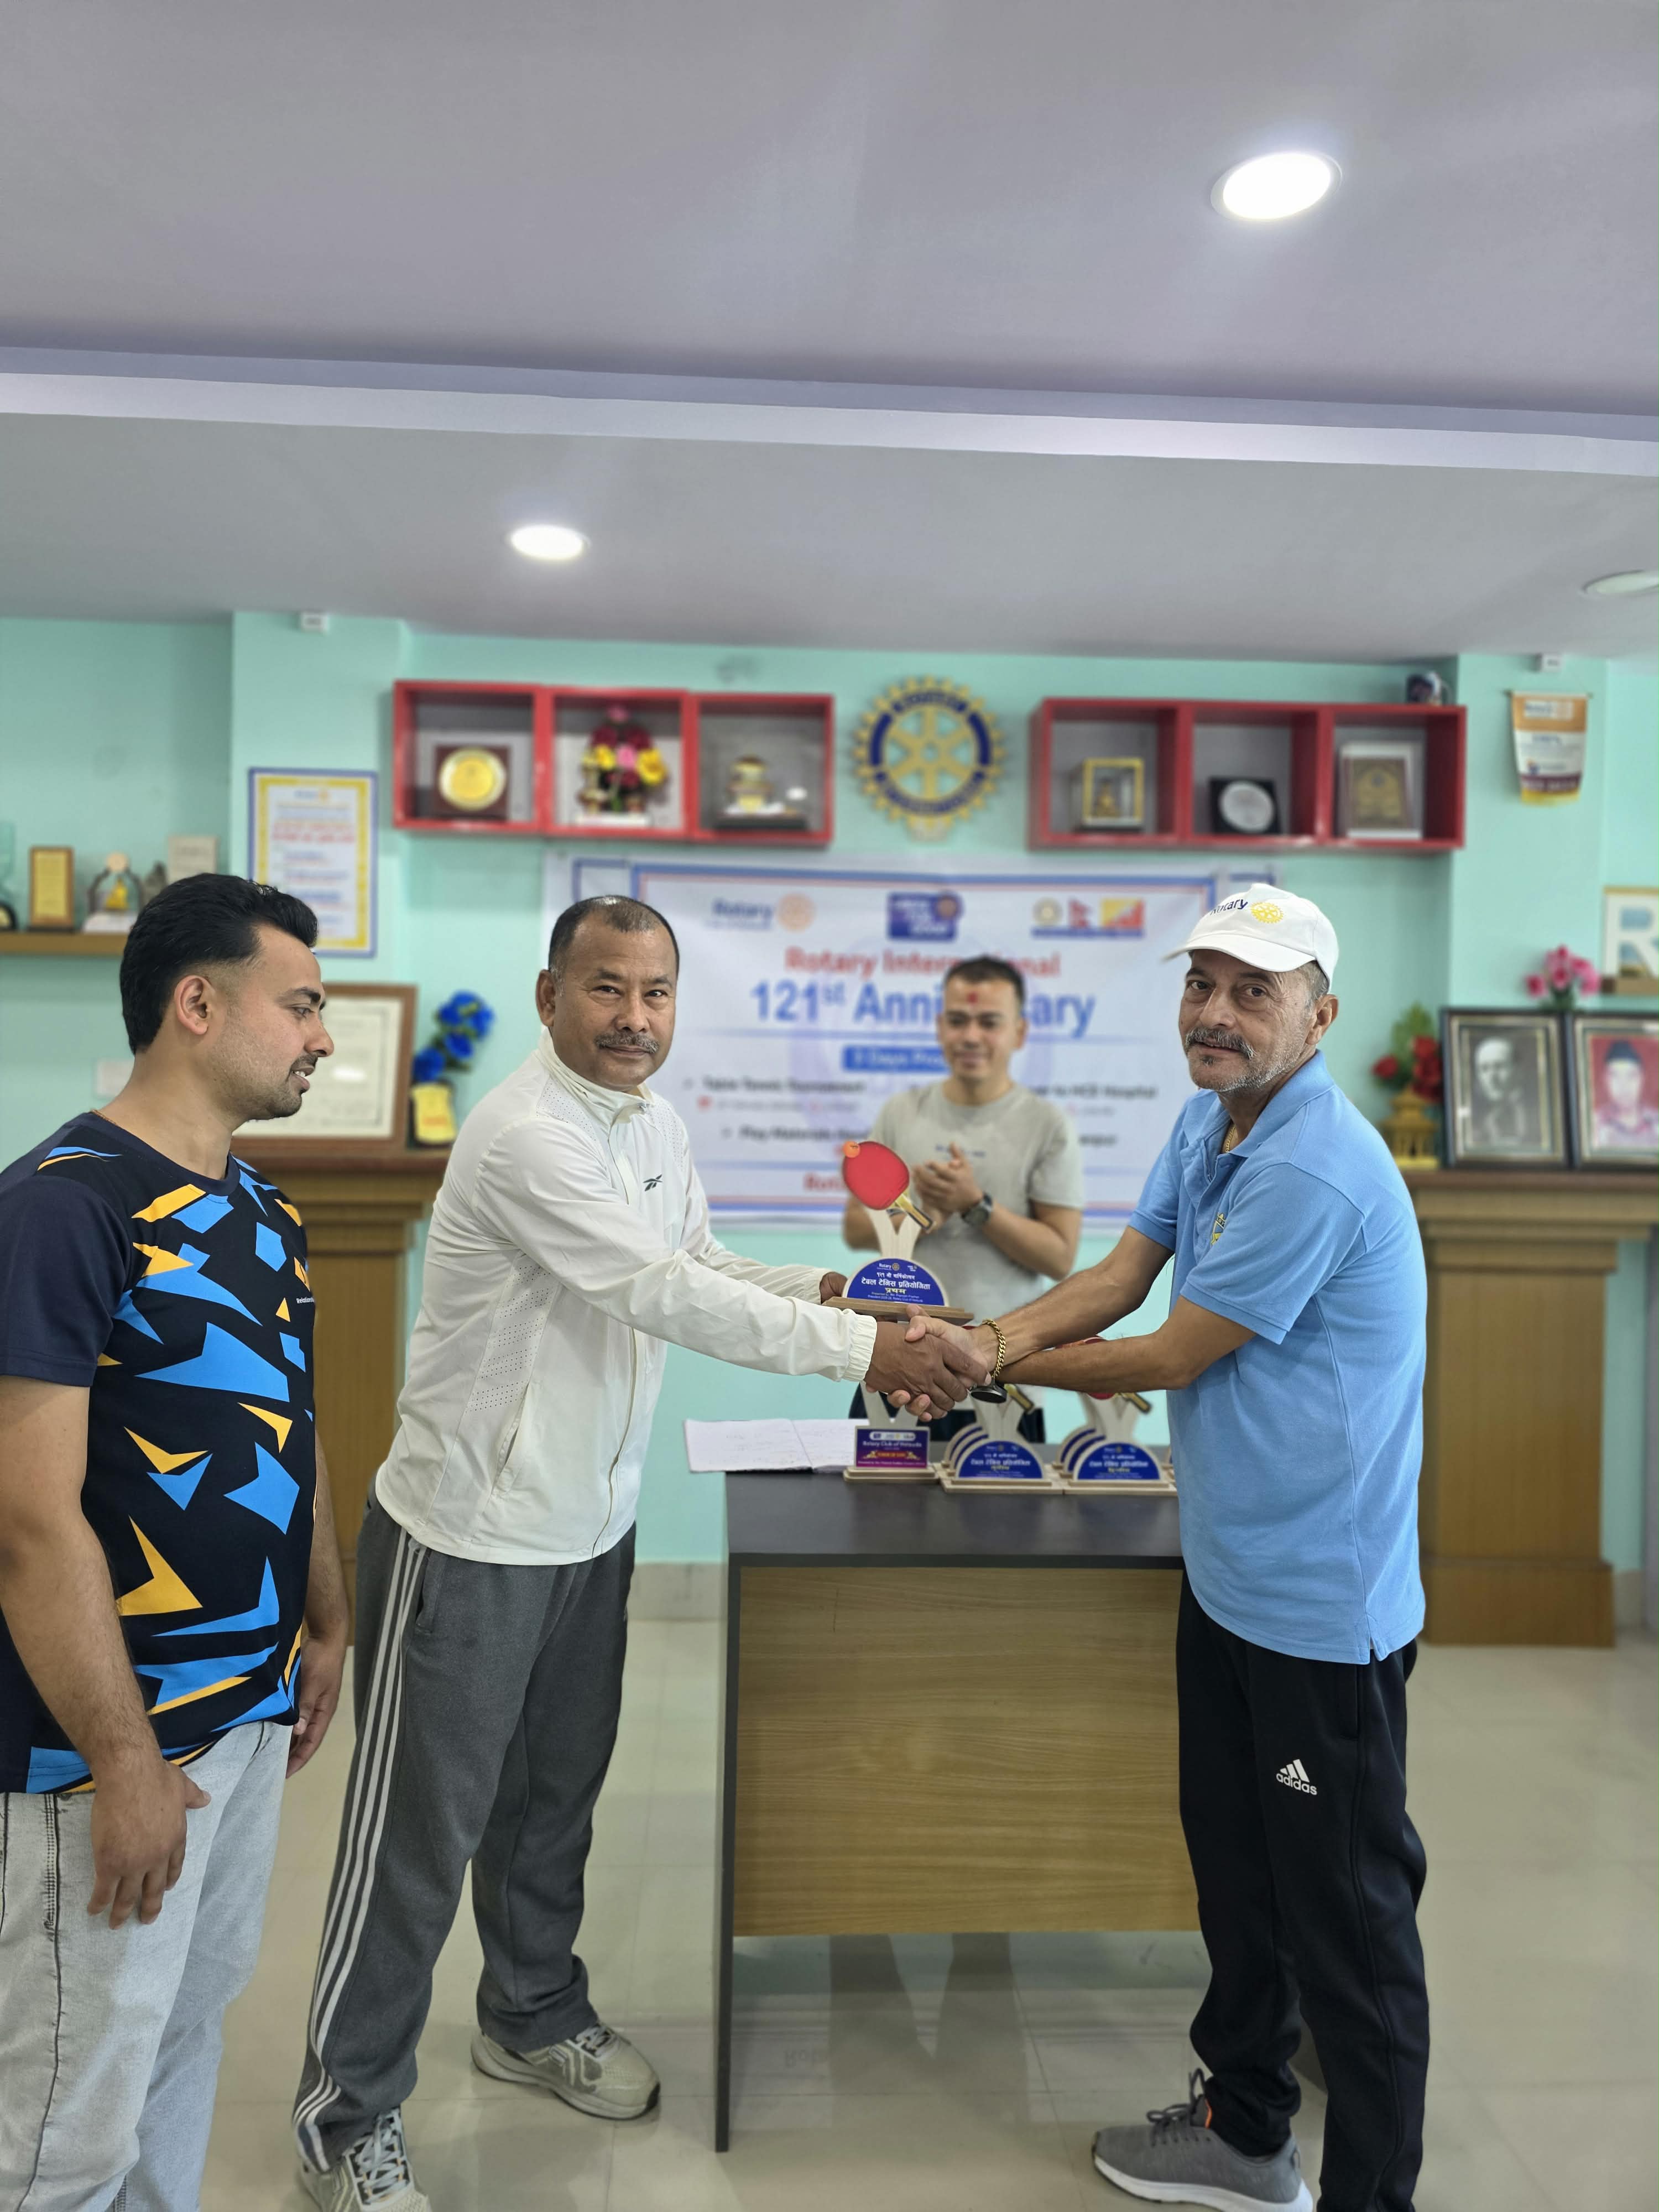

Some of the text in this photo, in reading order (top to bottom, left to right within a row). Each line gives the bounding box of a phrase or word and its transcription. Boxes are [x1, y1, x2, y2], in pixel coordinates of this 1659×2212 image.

[784, 946, 878, 980] Rotary
[853, 982, 1096, 1039] Anniary
[862, 1277, 931, 1290] टेबल टेनिस प्रतियोगिता
[1276, 1773, 1317, 1795] adidas
